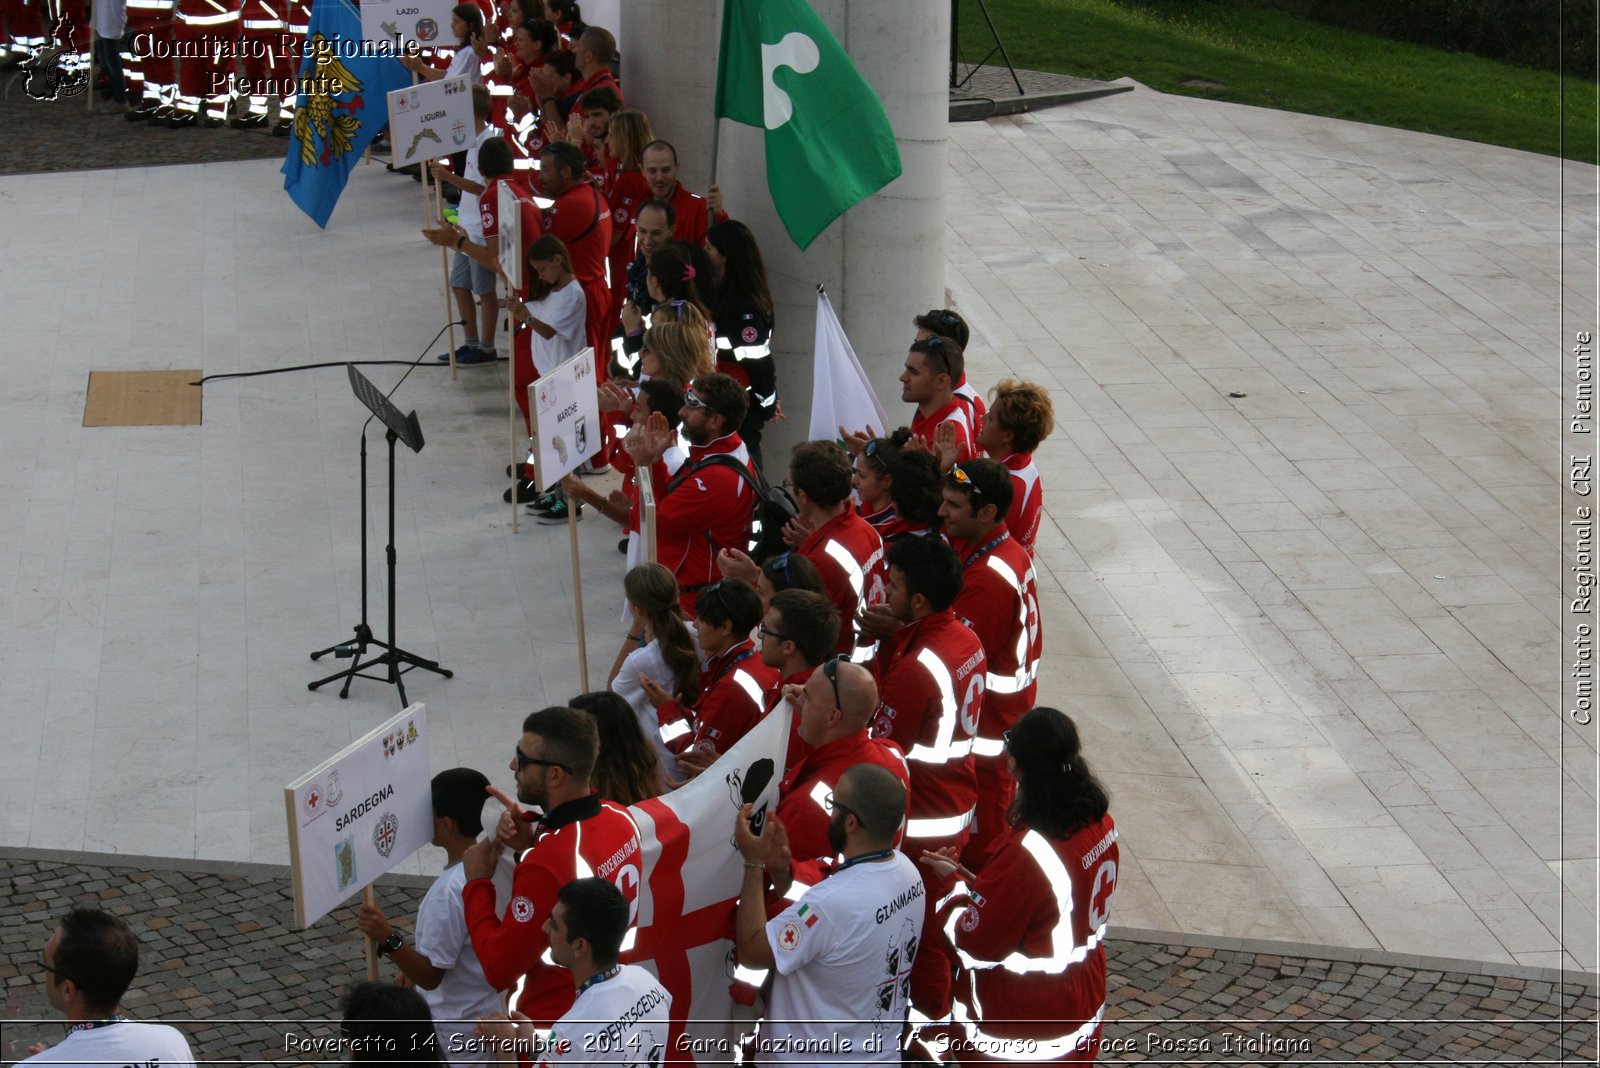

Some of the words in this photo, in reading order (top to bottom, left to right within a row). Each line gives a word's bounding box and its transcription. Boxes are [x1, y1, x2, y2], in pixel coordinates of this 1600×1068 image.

[396, 7, 420, 16] LAZIO
[420, 109, 447, 123] LIGURIA
[556, 401, 578, 424] MARCHE
[335, 783, 395, 833] SARDEGNA
